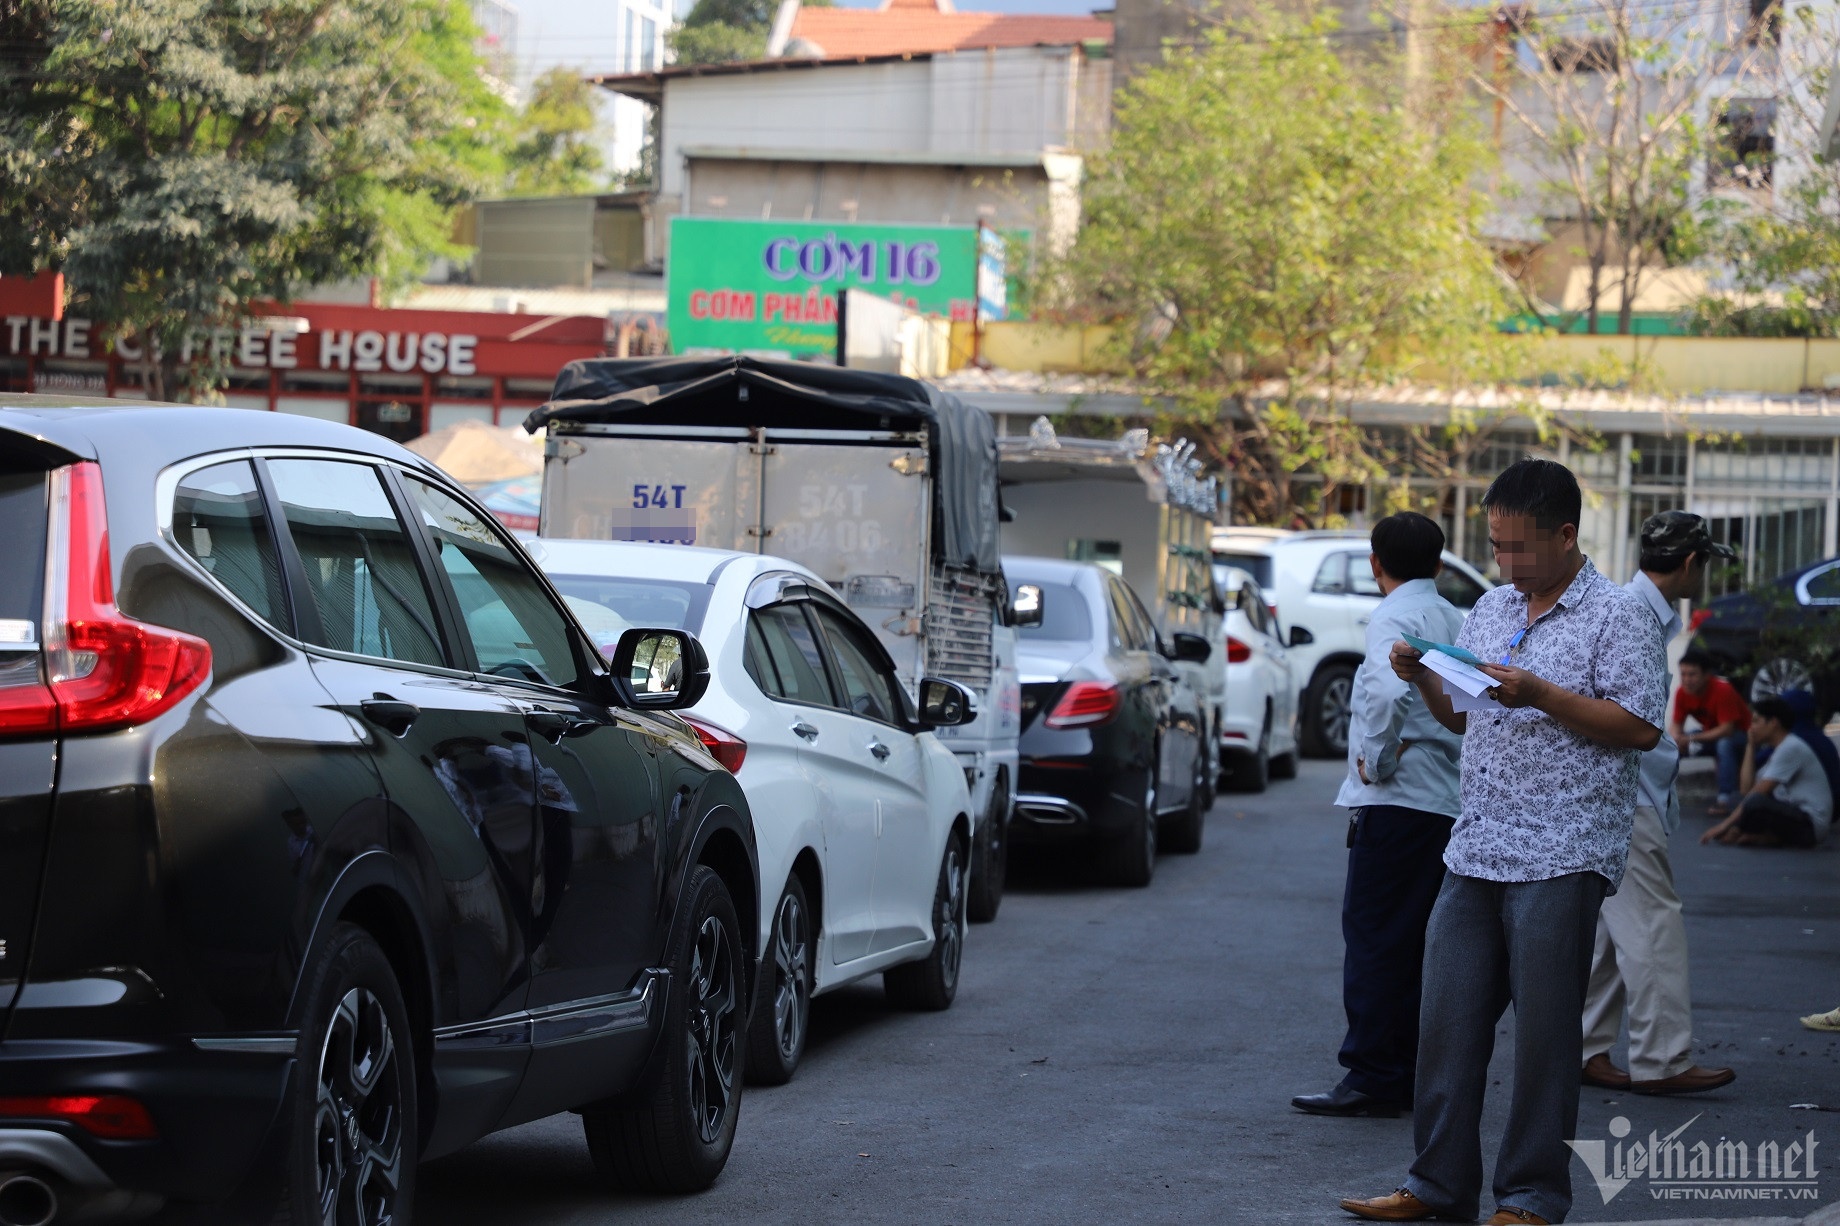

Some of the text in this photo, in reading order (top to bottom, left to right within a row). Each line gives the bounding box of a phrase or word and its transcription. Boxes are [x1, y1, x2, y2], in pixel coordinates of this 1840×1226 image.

[885, 240, 941, 286] 16
[6, 315, 92, 359] THE
[319, 328, 478, 375] HOUSE
[633, 484, 687, 509] 54T
